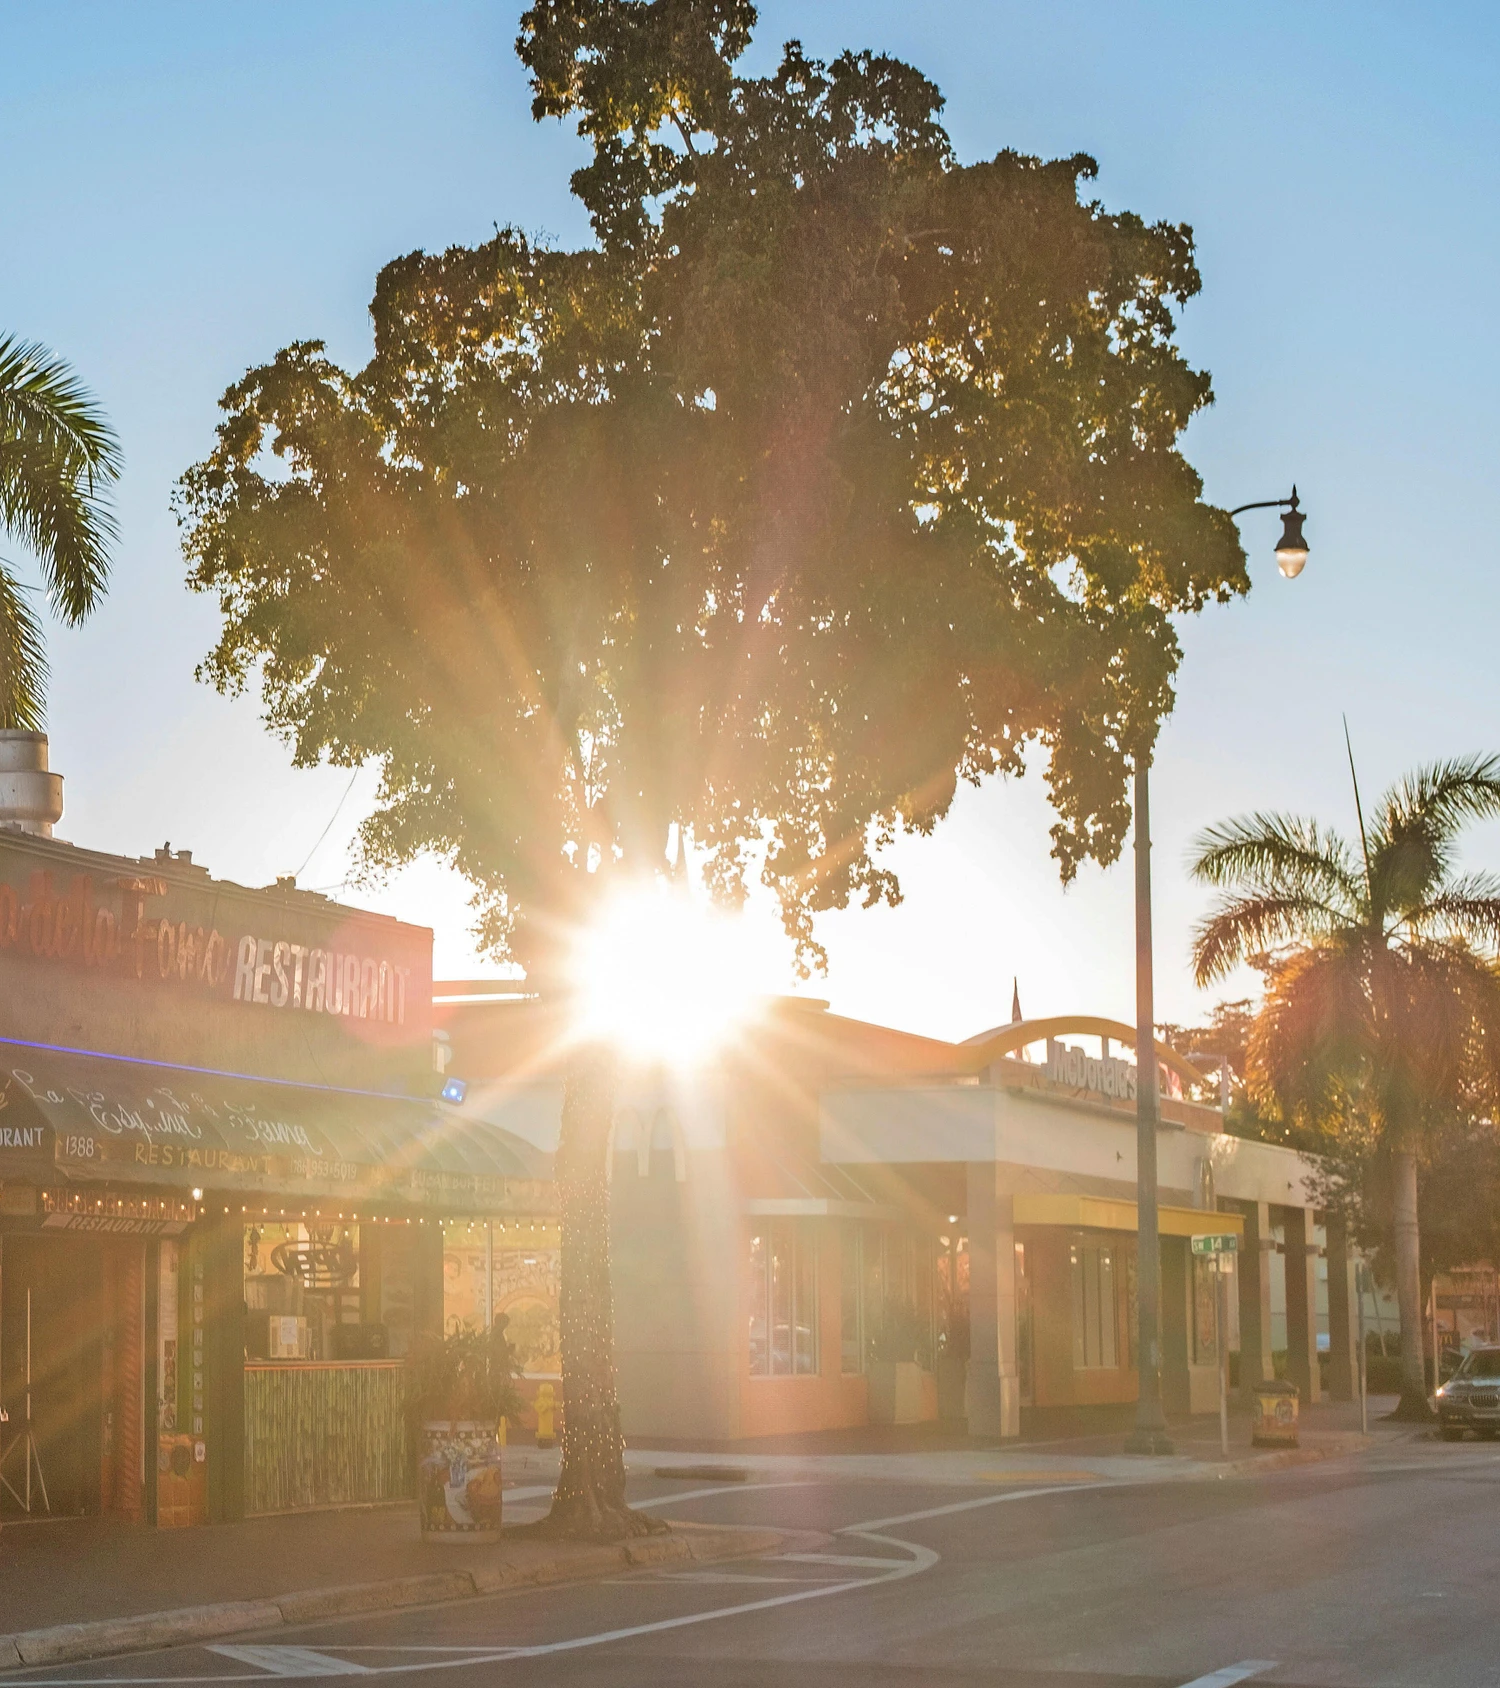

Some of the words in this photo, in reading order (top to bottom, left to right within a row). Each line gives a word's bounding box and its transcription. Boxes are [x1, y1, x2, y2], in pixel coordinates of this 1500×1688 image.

[112, 876, 234, 987] Fama
[233, 935, 411, 1026] RESTAURANT
[12, 1068, 64, 1104] La
[65, 1136, 94, 1158] 1388
[134, 1142, 272, 1176] RESTAURANT
[67, 1215, 166, 1235] RESTAURANT
[1210, 1236, 1223, 1252] 14
